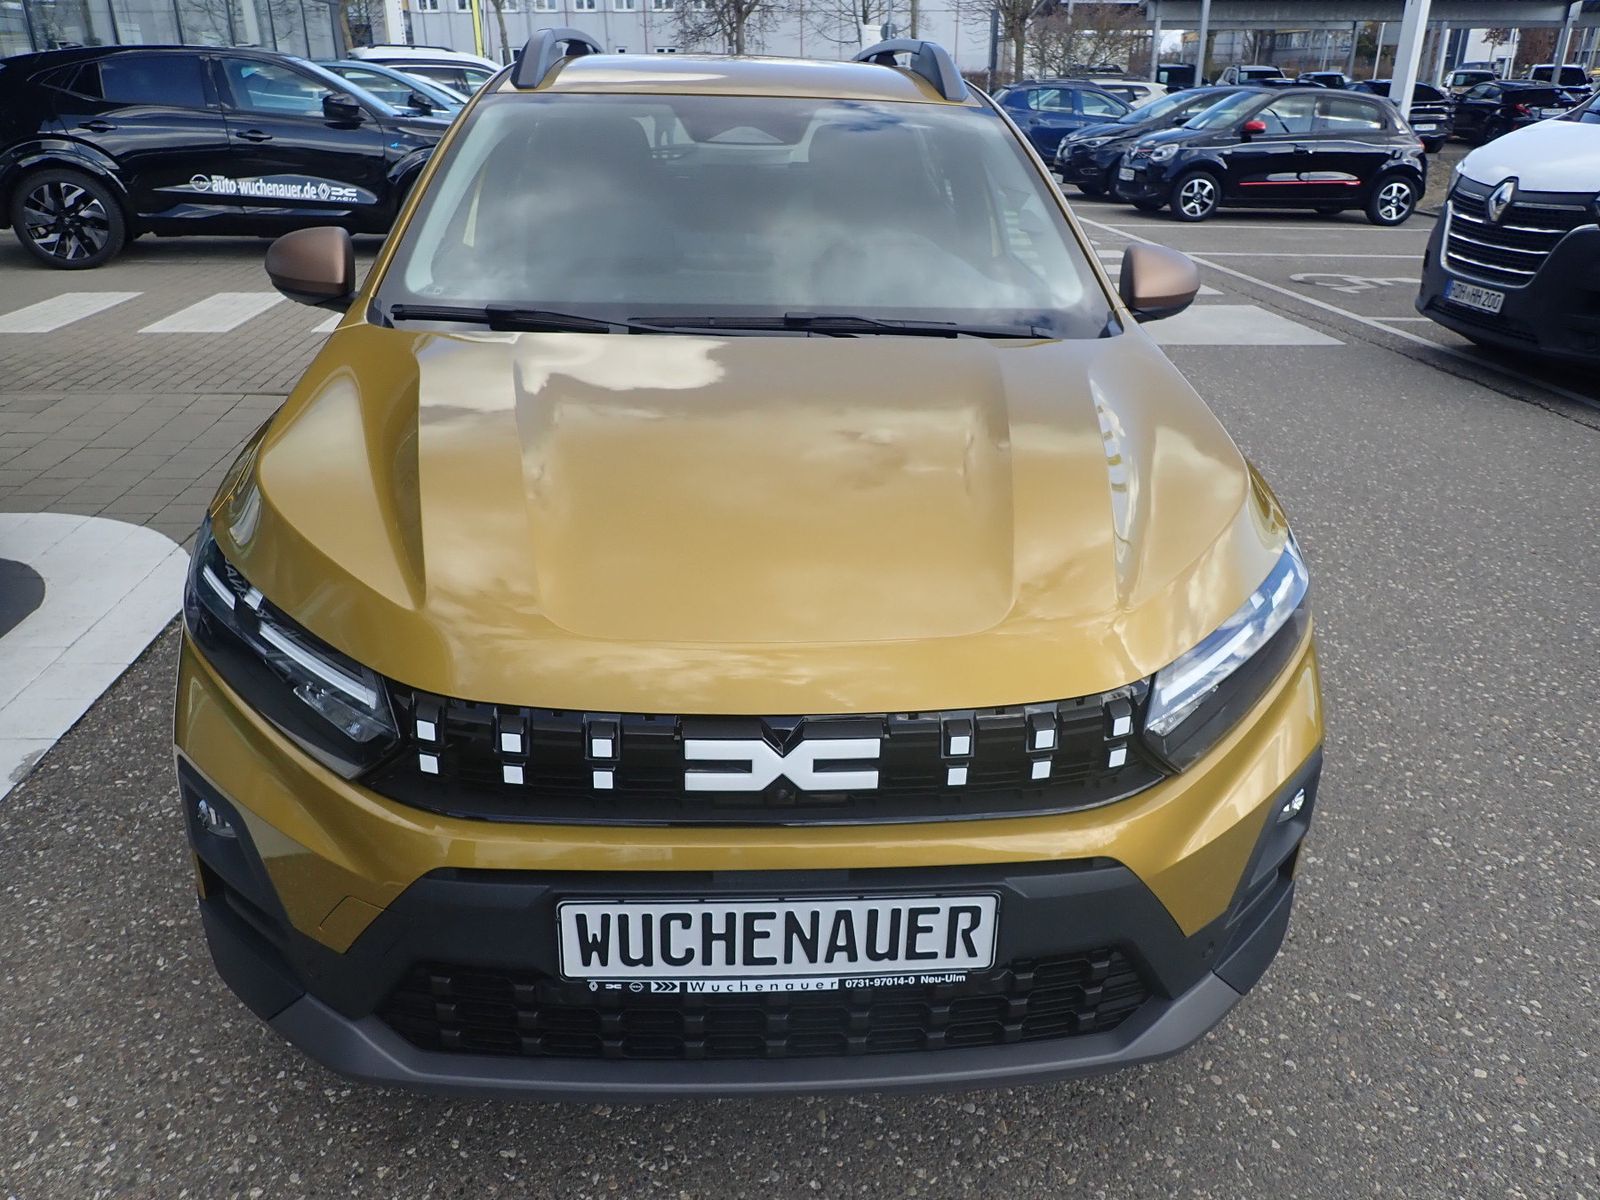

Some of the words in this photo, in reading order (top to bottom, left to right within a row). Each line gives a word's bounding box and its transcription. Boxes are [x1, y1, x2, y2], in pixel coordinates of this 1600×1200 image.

[575, 905, 982, 967] WUCHENAUER
[690, 980, 837, 992] Wuchenauer
[845, 976, 915, 988] 0731-97014-0
[920, 974, 966, 985] Neu-Ulm
